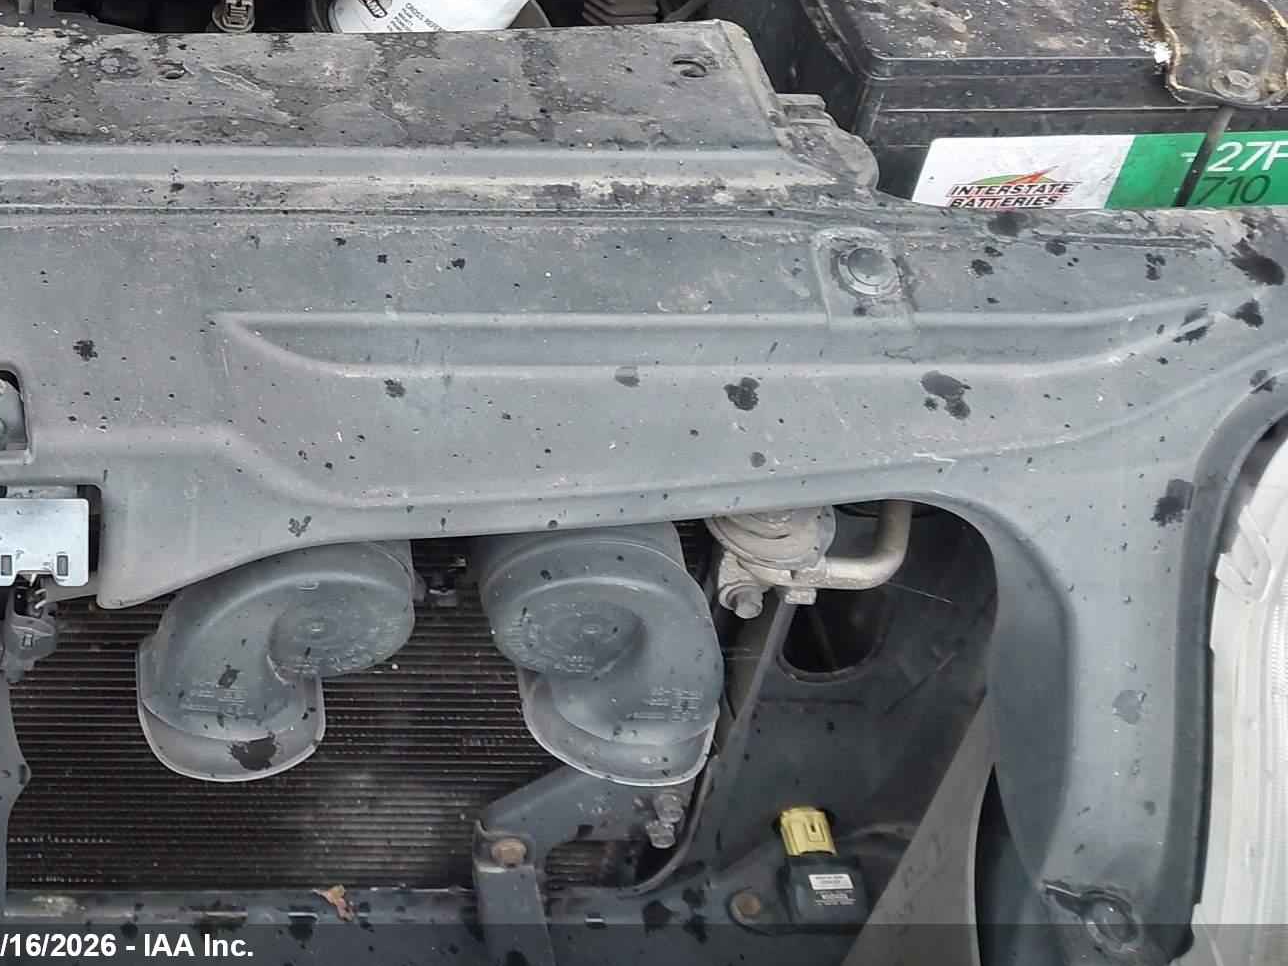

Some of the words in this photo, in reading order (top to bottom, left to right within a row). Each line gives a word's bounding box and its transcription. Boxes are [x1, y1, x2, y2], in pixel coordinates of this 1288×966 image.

[950, 183, 1074, 196] INTERSTATE
[1194, 174, 1272, 205] 710
[949, 195, 1060, 209] BATTERIES
